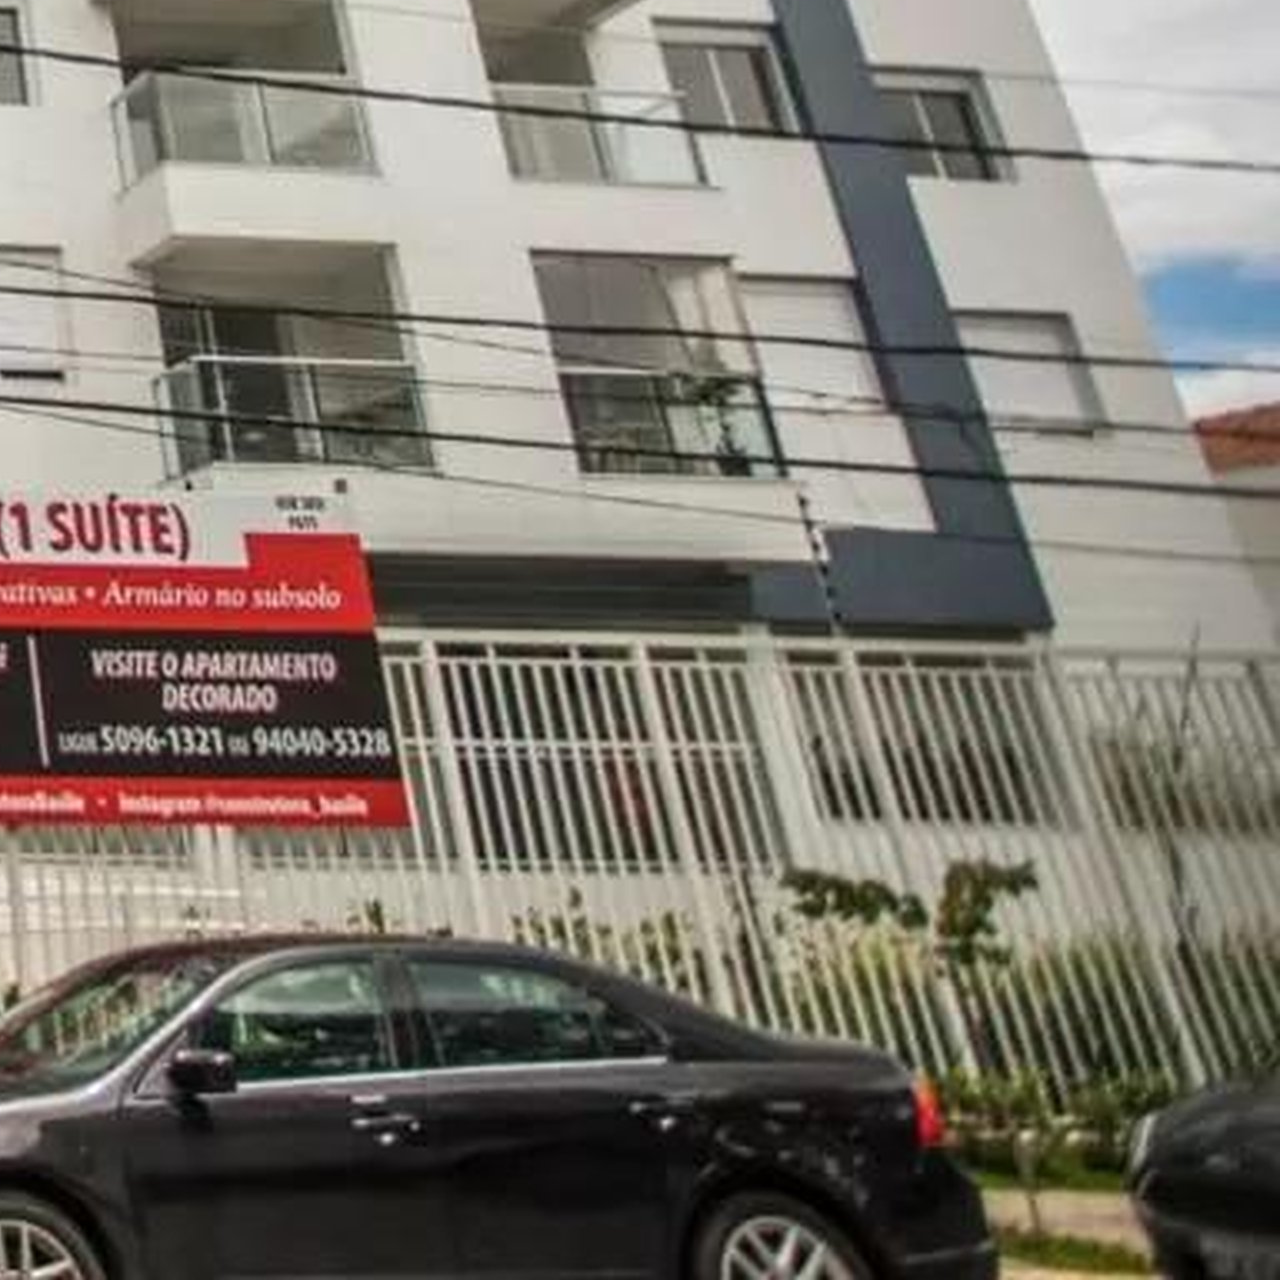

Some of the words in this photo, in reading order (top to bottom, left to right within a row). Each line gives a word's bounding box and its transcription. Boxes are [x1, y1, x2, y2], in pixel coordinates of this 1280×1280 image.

[47, 493, 190, 562] SUÍTE)
[102, 581, 208, 609] Armário
[214, 590, 247, 609] no
[252, 582, 341, 611] subsolo
[90, 650, 159, 678] VISITE
[162, 652, 179, 678] O
[182, 651, 337, 681] APARTAMENTO
[161, 684, 278, 711] DECORADO
[100, 726, 225, 754] 5096-1321
[252, 727, 391, 757] 94040-5328
